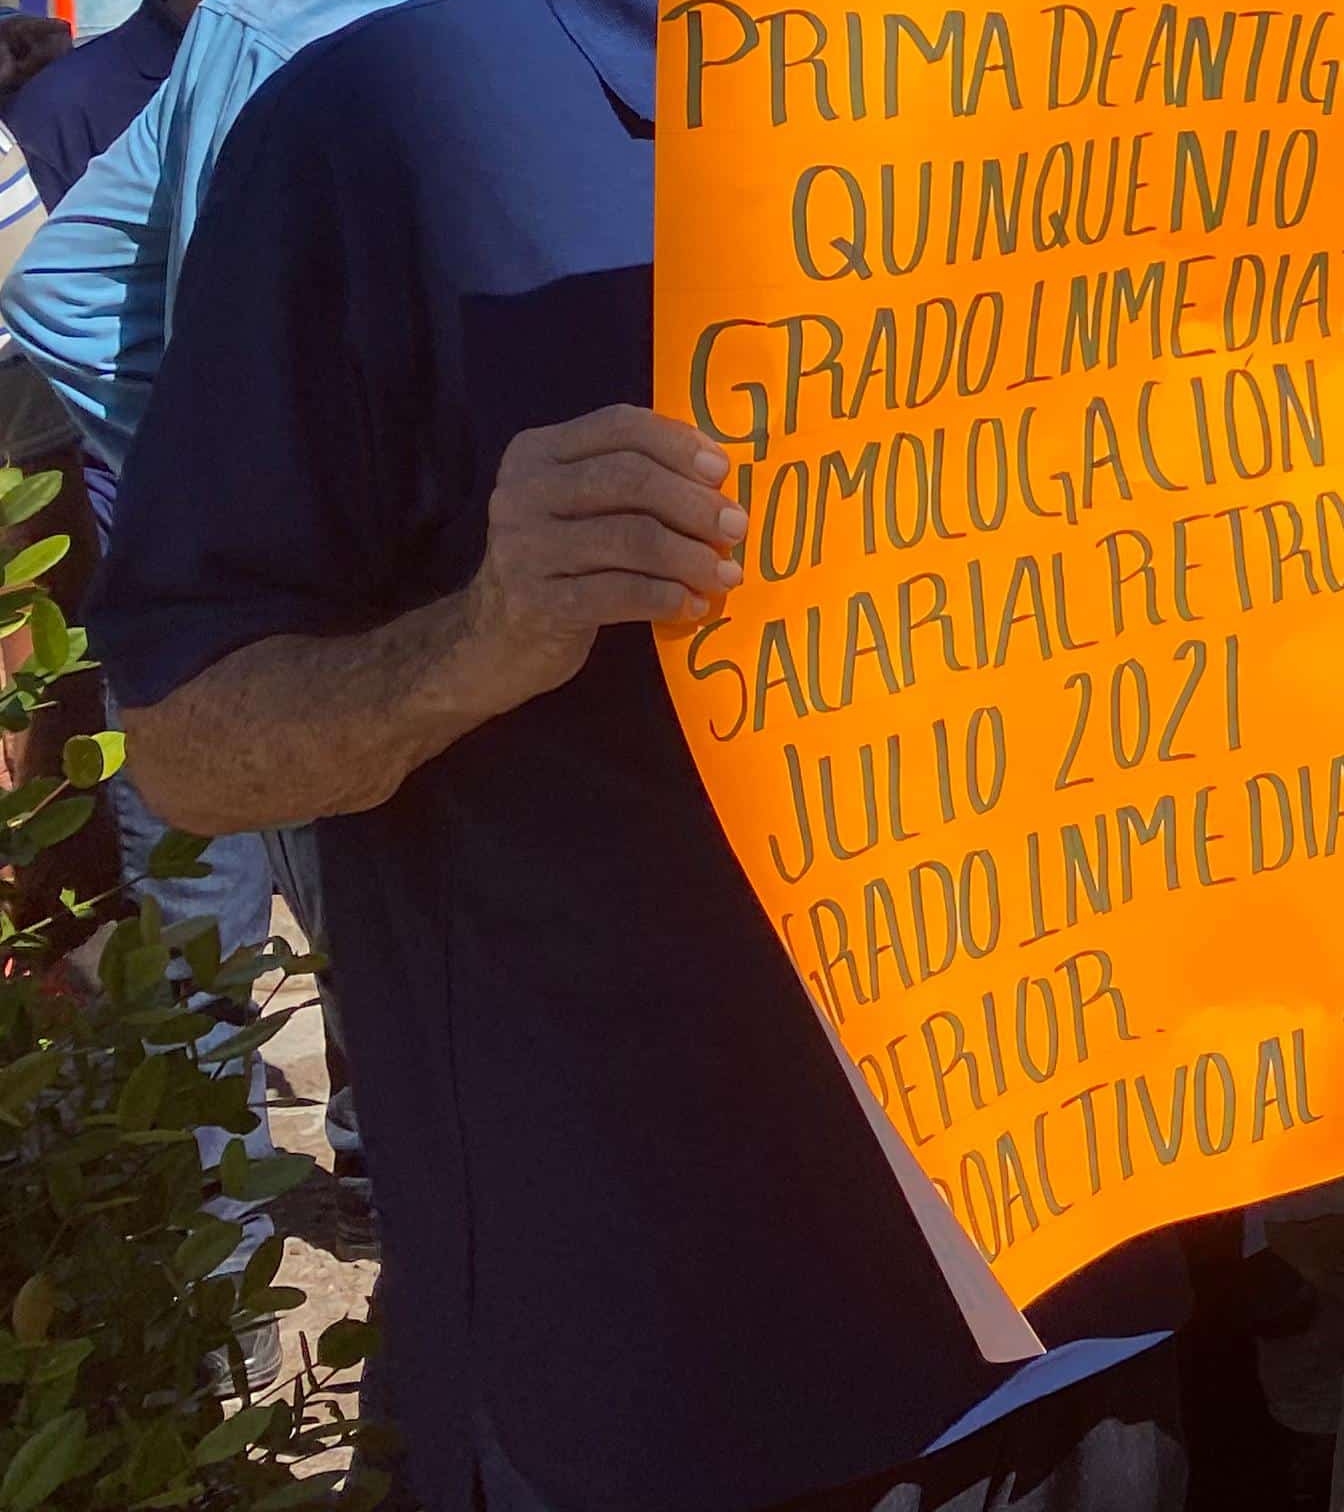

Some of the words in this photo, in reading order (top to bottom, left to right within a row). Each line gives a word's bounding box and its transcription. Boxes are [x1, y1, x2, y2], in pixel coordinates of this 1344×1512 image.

[791, 128, 1318, 283] QUINQUENIO
[690, 292, 1004, 463] GRADO
[686, 552, 1098, 743] SALARIAL
[769, 706, 1007, 885] JULIO
[1053, 634, 1242, 793] 2021
[1251, 1028, 1324, 1146] AL
